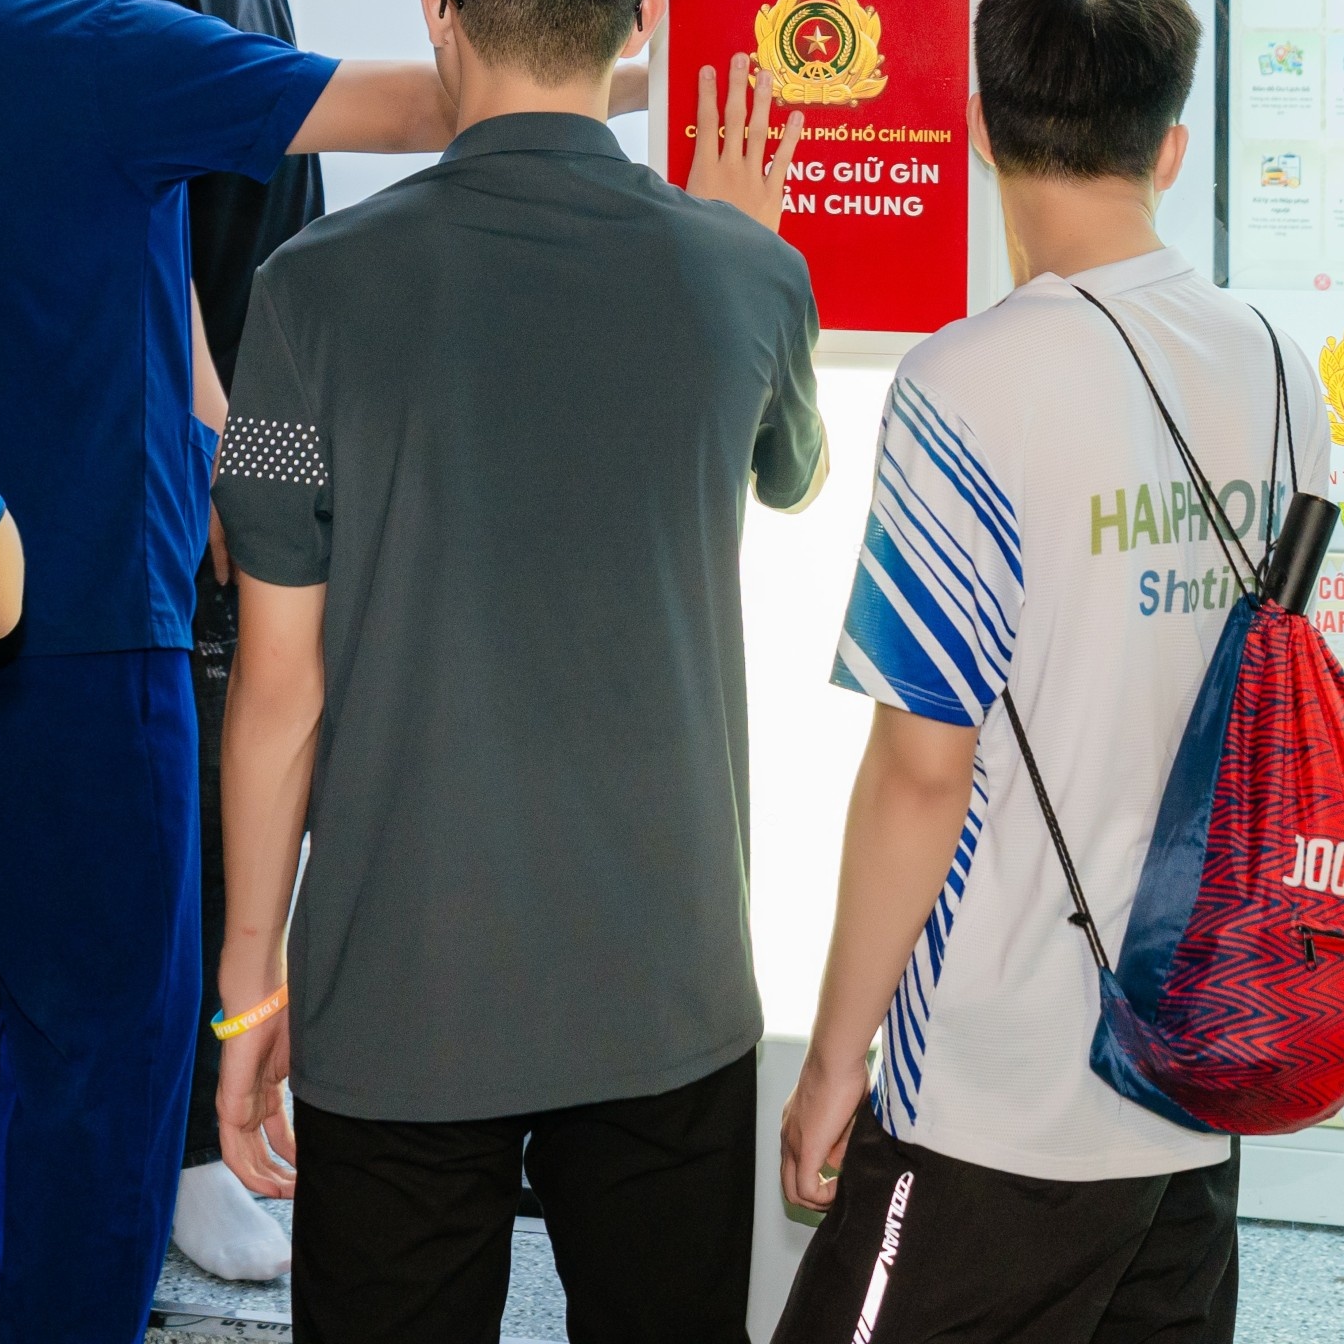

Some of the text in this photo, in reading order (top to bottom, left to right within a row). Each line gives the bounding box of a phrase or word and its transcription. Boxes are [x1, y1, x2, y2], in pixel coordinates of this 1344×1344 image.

[815, 123, 848, 140] PHỐ
[878, 125, 906, 142] CHÍ
[909, 129, 951, 143] MINH
[833, 156, 884, 183] GIỮ
[890, 157, 939, 184] GÌN
[780, 186, 924, 216] ẢN CHUNG
[878, 1170, 915, 1266] COOLMAN
